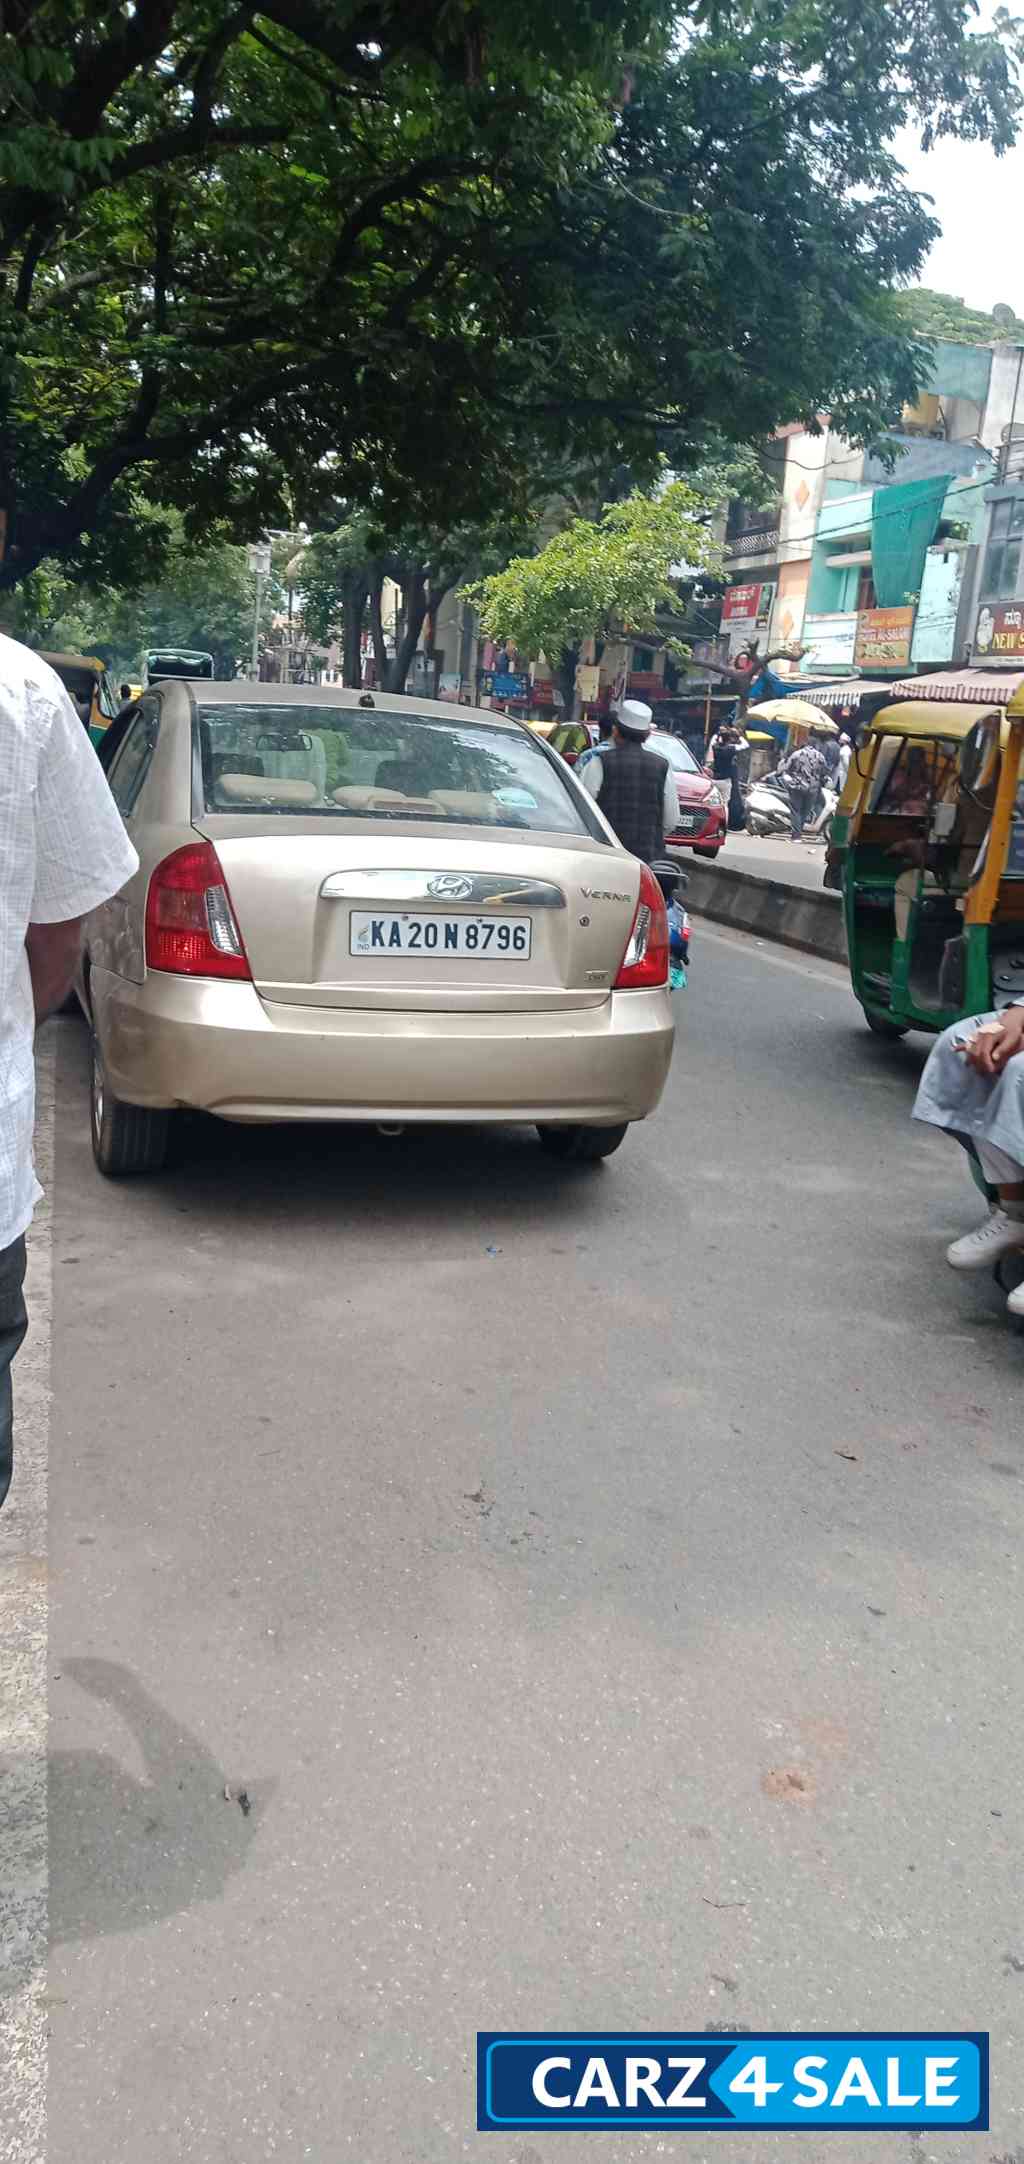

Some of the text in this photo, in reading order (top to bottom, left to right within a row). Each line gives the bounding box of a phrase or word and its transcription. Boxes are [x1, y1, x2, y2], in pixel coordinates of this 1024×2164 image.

[580, 888, 633, 903] VERNA
[371, 920, 526, 951] KA 20 N 8796
